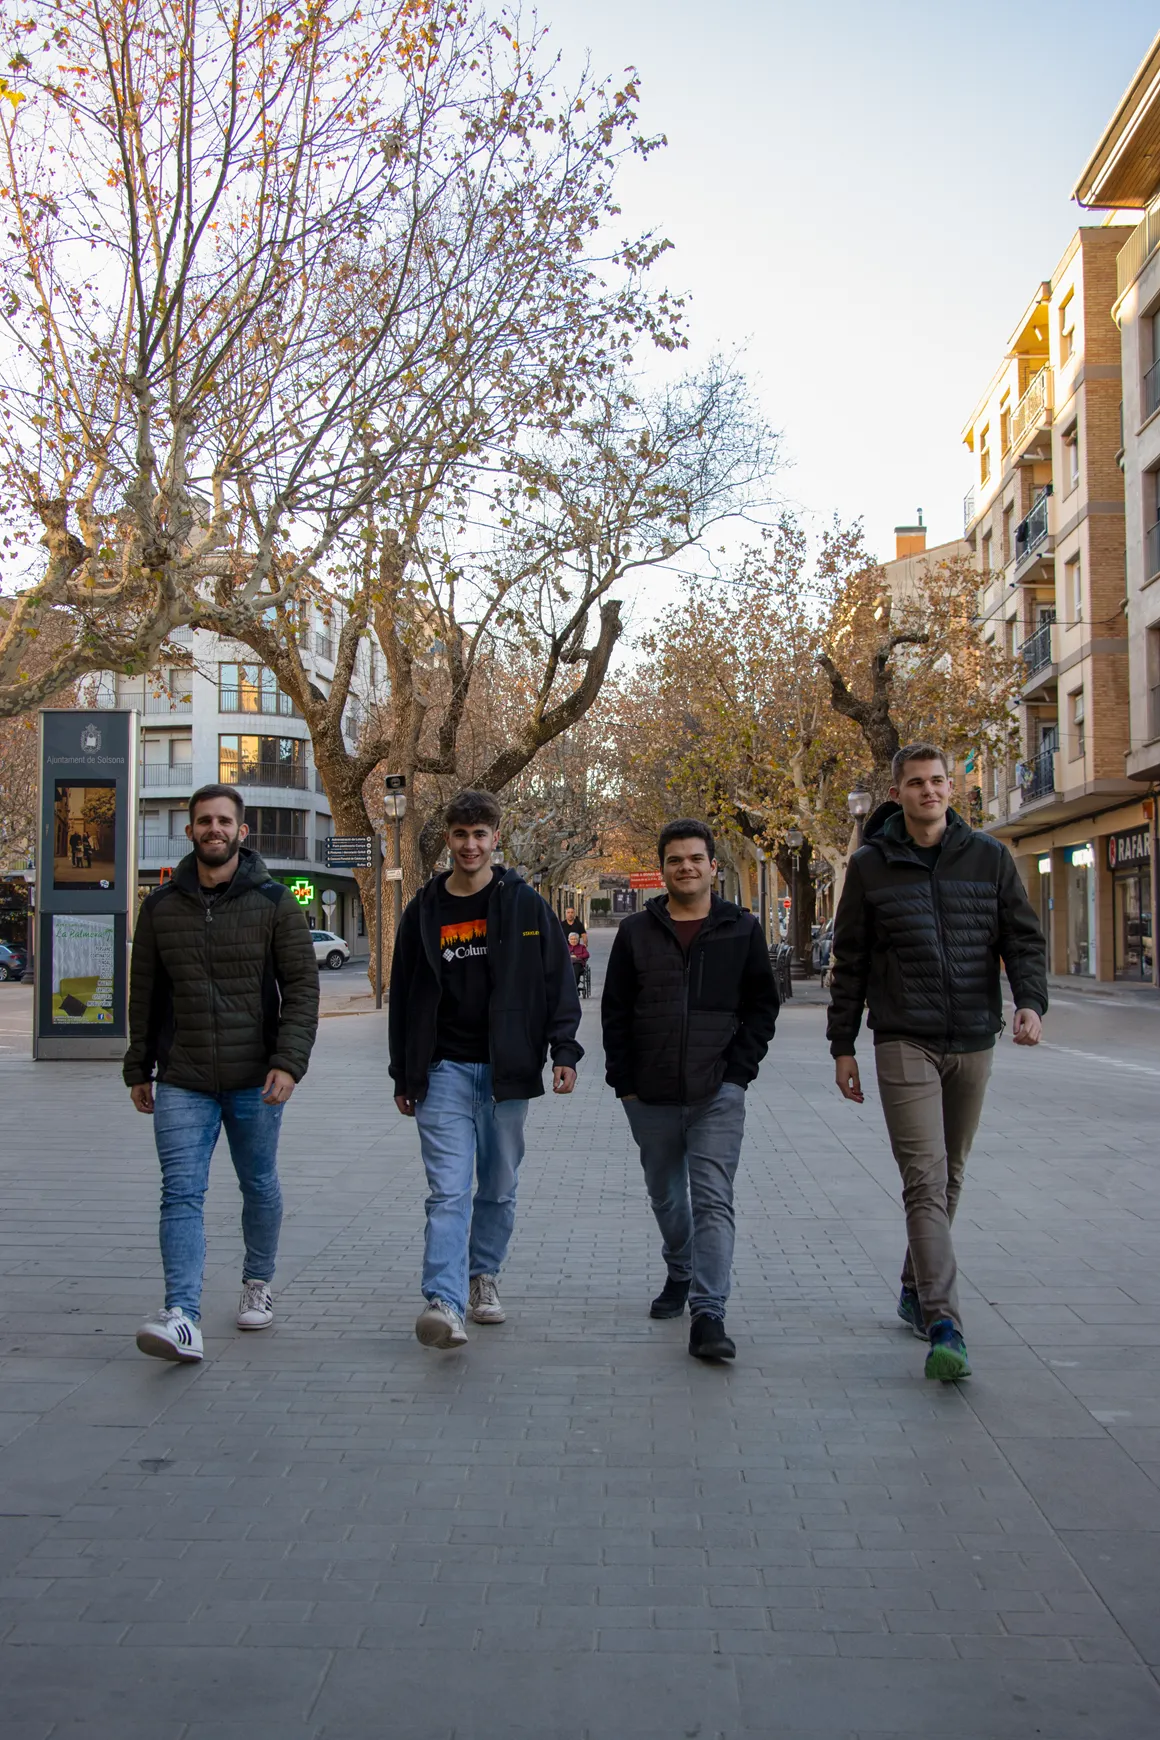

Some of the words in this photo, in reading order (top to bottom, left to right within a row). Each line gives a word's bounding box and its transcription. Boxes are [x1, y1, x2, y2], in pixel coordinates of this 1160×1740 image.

[46, 756, 85, 764] Ajuntament
[86, 756, 96, 764] de
[97, 756, 125, 764] Solsona
